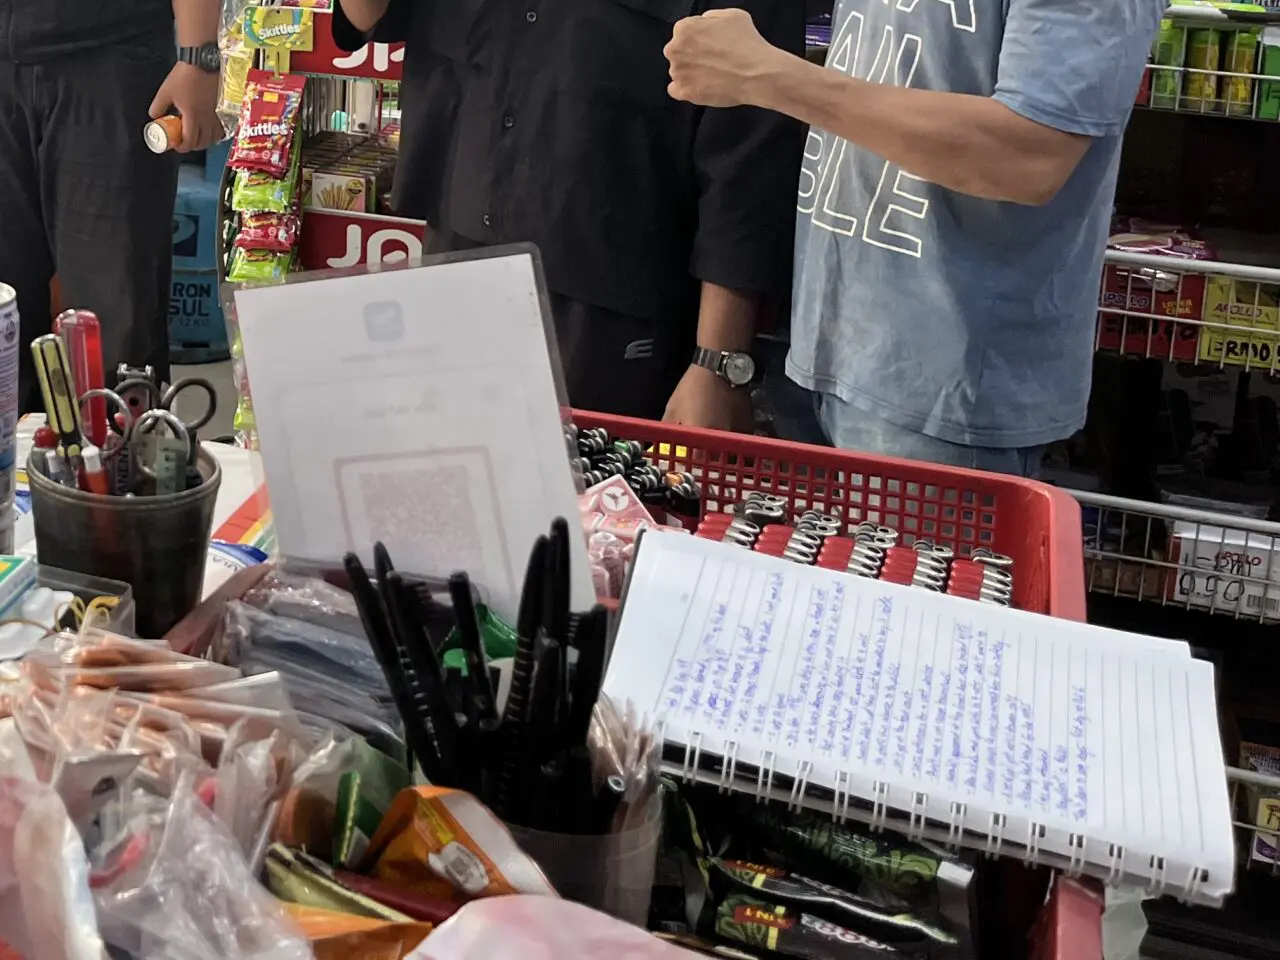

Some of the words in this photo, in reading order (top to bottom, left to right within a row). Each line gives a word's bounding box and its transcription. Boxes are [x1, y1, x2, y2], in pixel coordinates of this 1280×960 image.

[258, 24, 301, 40] Skittles
[238, 121, 288, 139] Skittles
[173, 282, 212, 299] RON
